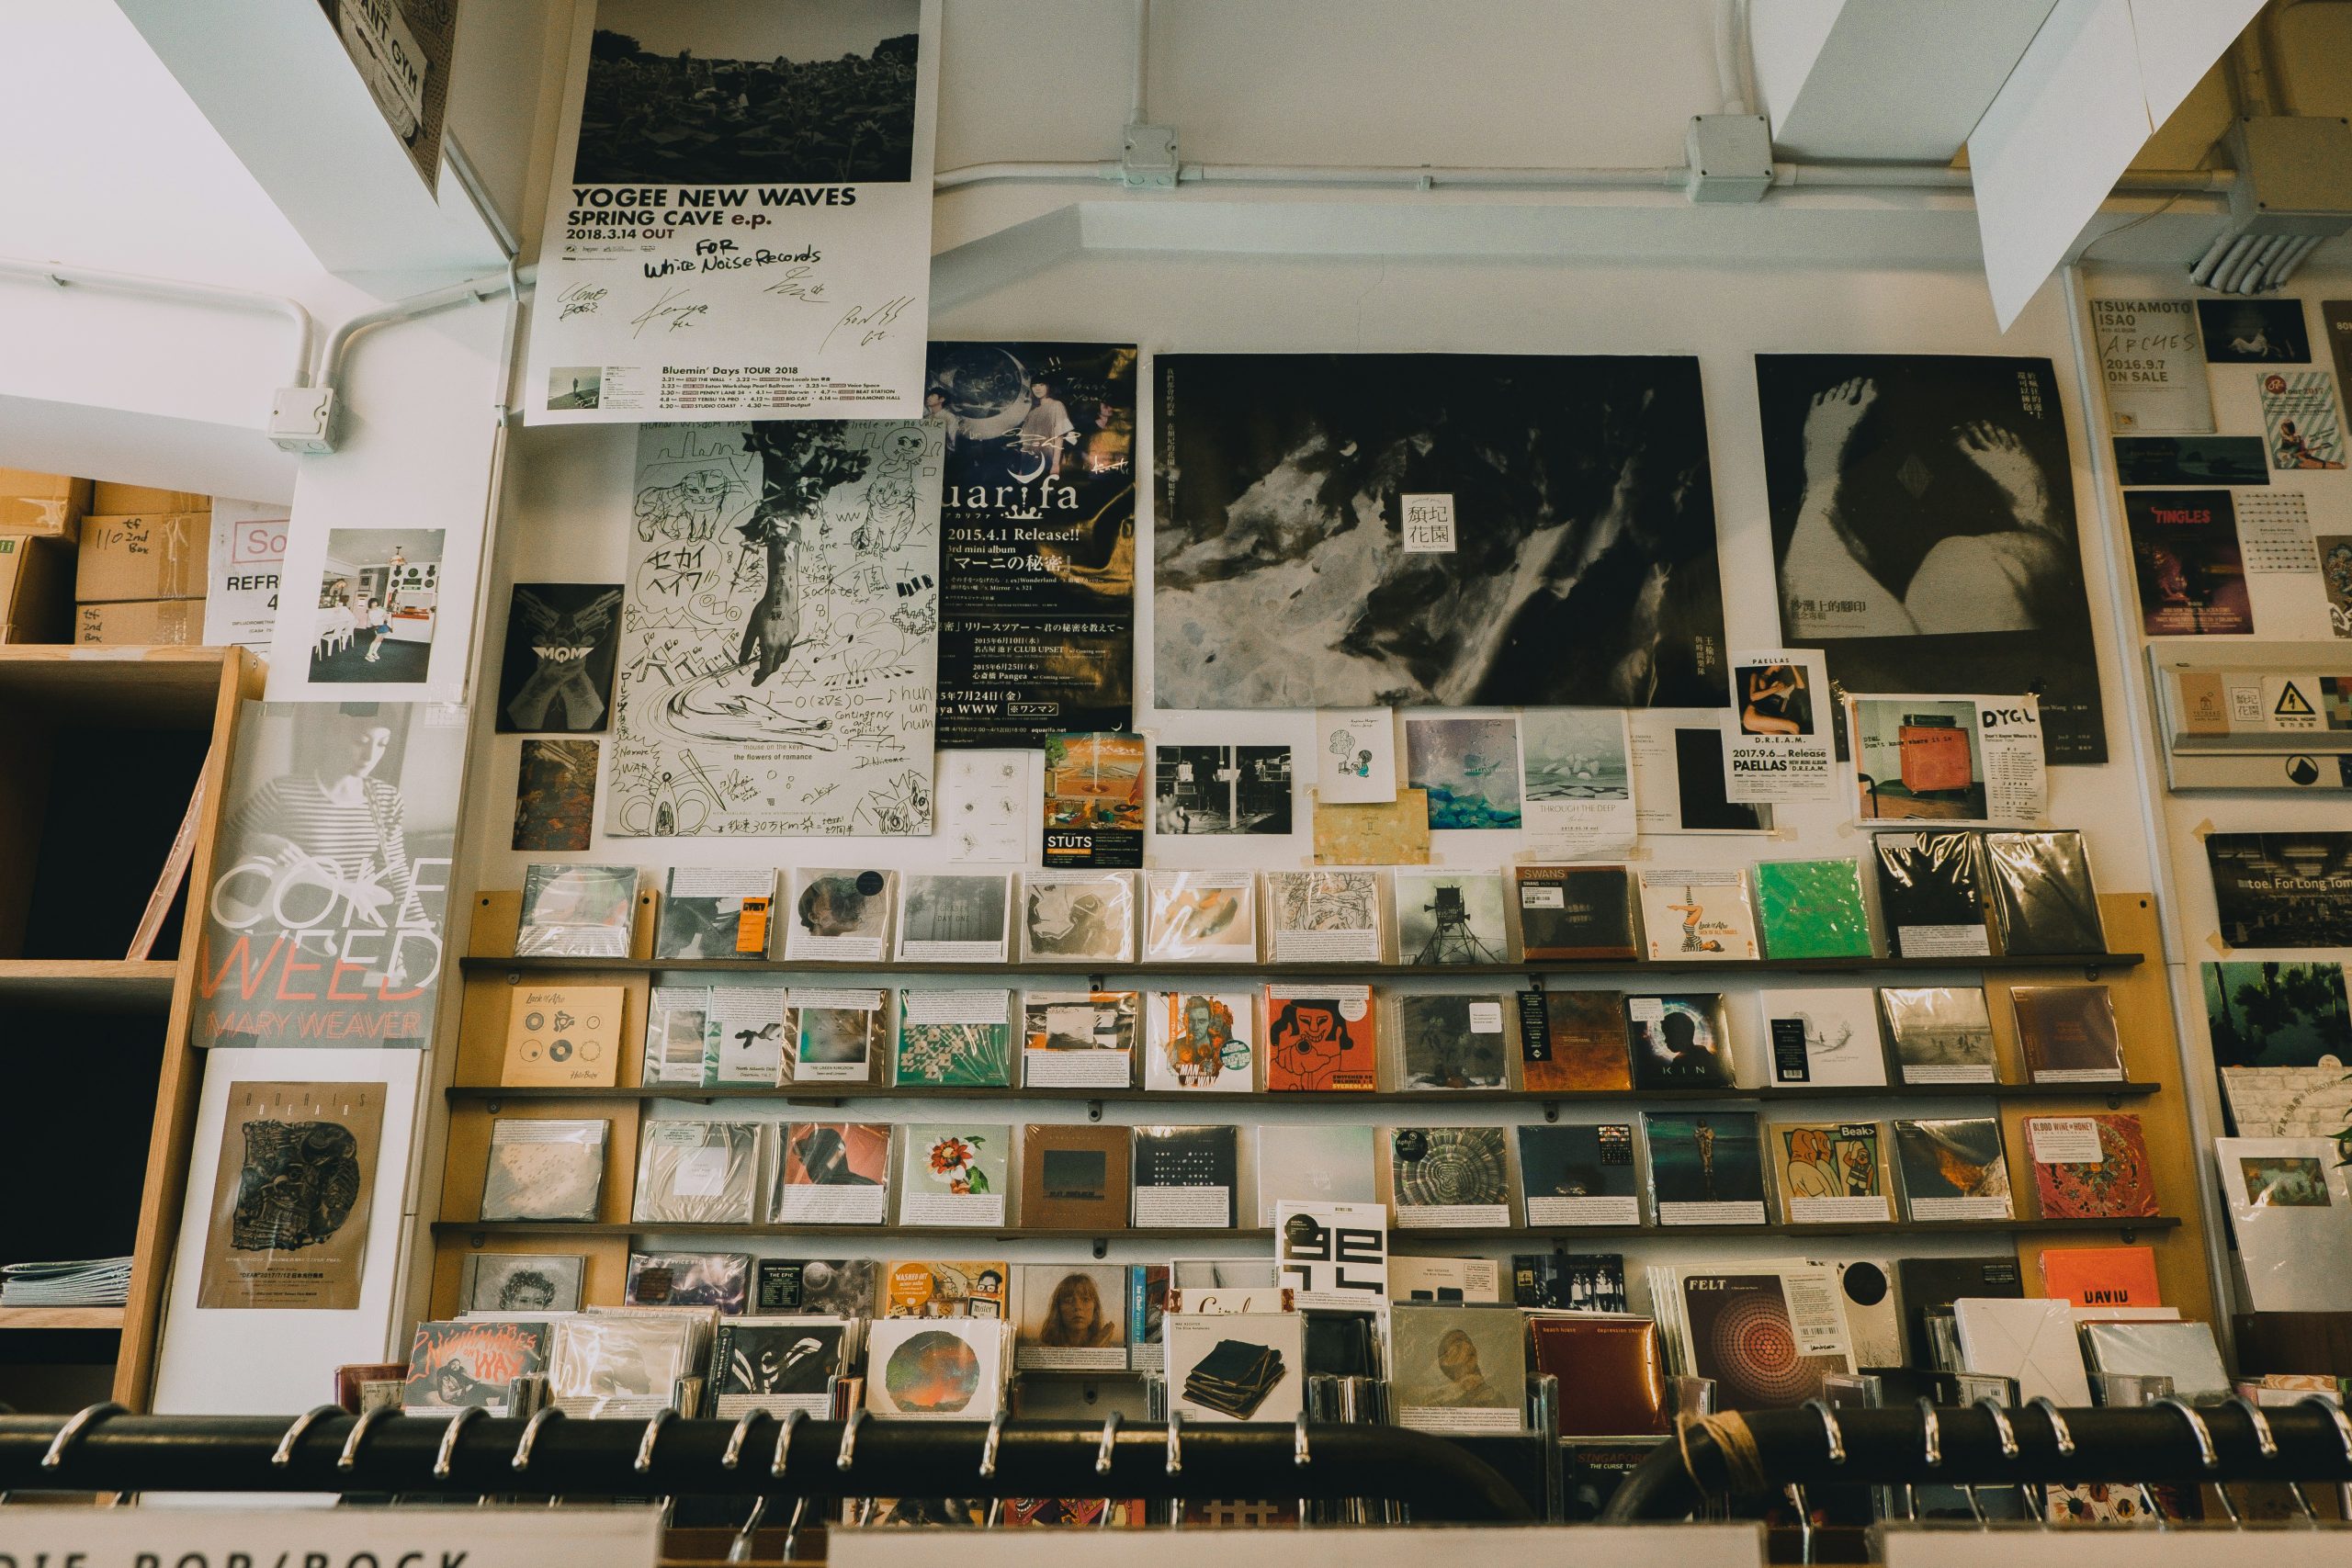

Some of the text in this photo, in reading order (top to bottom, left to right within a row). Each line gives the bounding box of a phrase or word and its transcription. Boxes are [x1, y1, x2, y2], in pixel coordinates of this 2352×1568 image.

[391, 39, 417, 95] GYM
[572, 187, 856, 207] YOGEE NEW WAVES
[568, 210, 772, 229] SPRING CAVE e.p.
[566, 230, 674, 240] 2018.3.14 OUT
[695, 239, 739, 255] FOR
[644, 244, 821, 278] White Noise Records
[2094, 300, 2192, 314] TSUKAMOTO
[2099, 314, 2136, 326] ISAO
[2107, 359, 2165, 369] 2016.9.7
[713, 367, 740, 376] Days
[2109, 372, 2169, 382] ON SALE
[2151, 506, 2211, 524] TINGLES
[126, 530, 149, 542] 2nd
[947, 528, 1080, 541] 2015.4.1 Release!!
[130, 543, 149, 554] Box
[988, 546, 1016, 554] album
[958, 705, 998, 714] WWW
[1982, 708, 2035, 728] DYGL
[1733, 749, 1826, 758] 2017.9.6 Release
[1733, 761, 1787, 771] PAELLAS
[1581, 805, 1596, 813] THE
[1047, 837, 1091, 848] STUTS
[1524, 870, 1566, 878] SWANS
[2275, 878, 2326, 891] For Long
[202, 930, 443, 1000] WEED
[206, 1010, 421, 1039] MARY WEAVER
[1180, 1065, 1199, 1076] MAN
[1663, 1066, 1705, 1075] KIN
[1842, 1126, 1874, 1135] Beak>
[2033, 1122, 2093, 1131] BLOOD WINE HONEY
[1689, 1280, 1726, 1291] FELT
[475, 1349, 525, 1382] WAX
